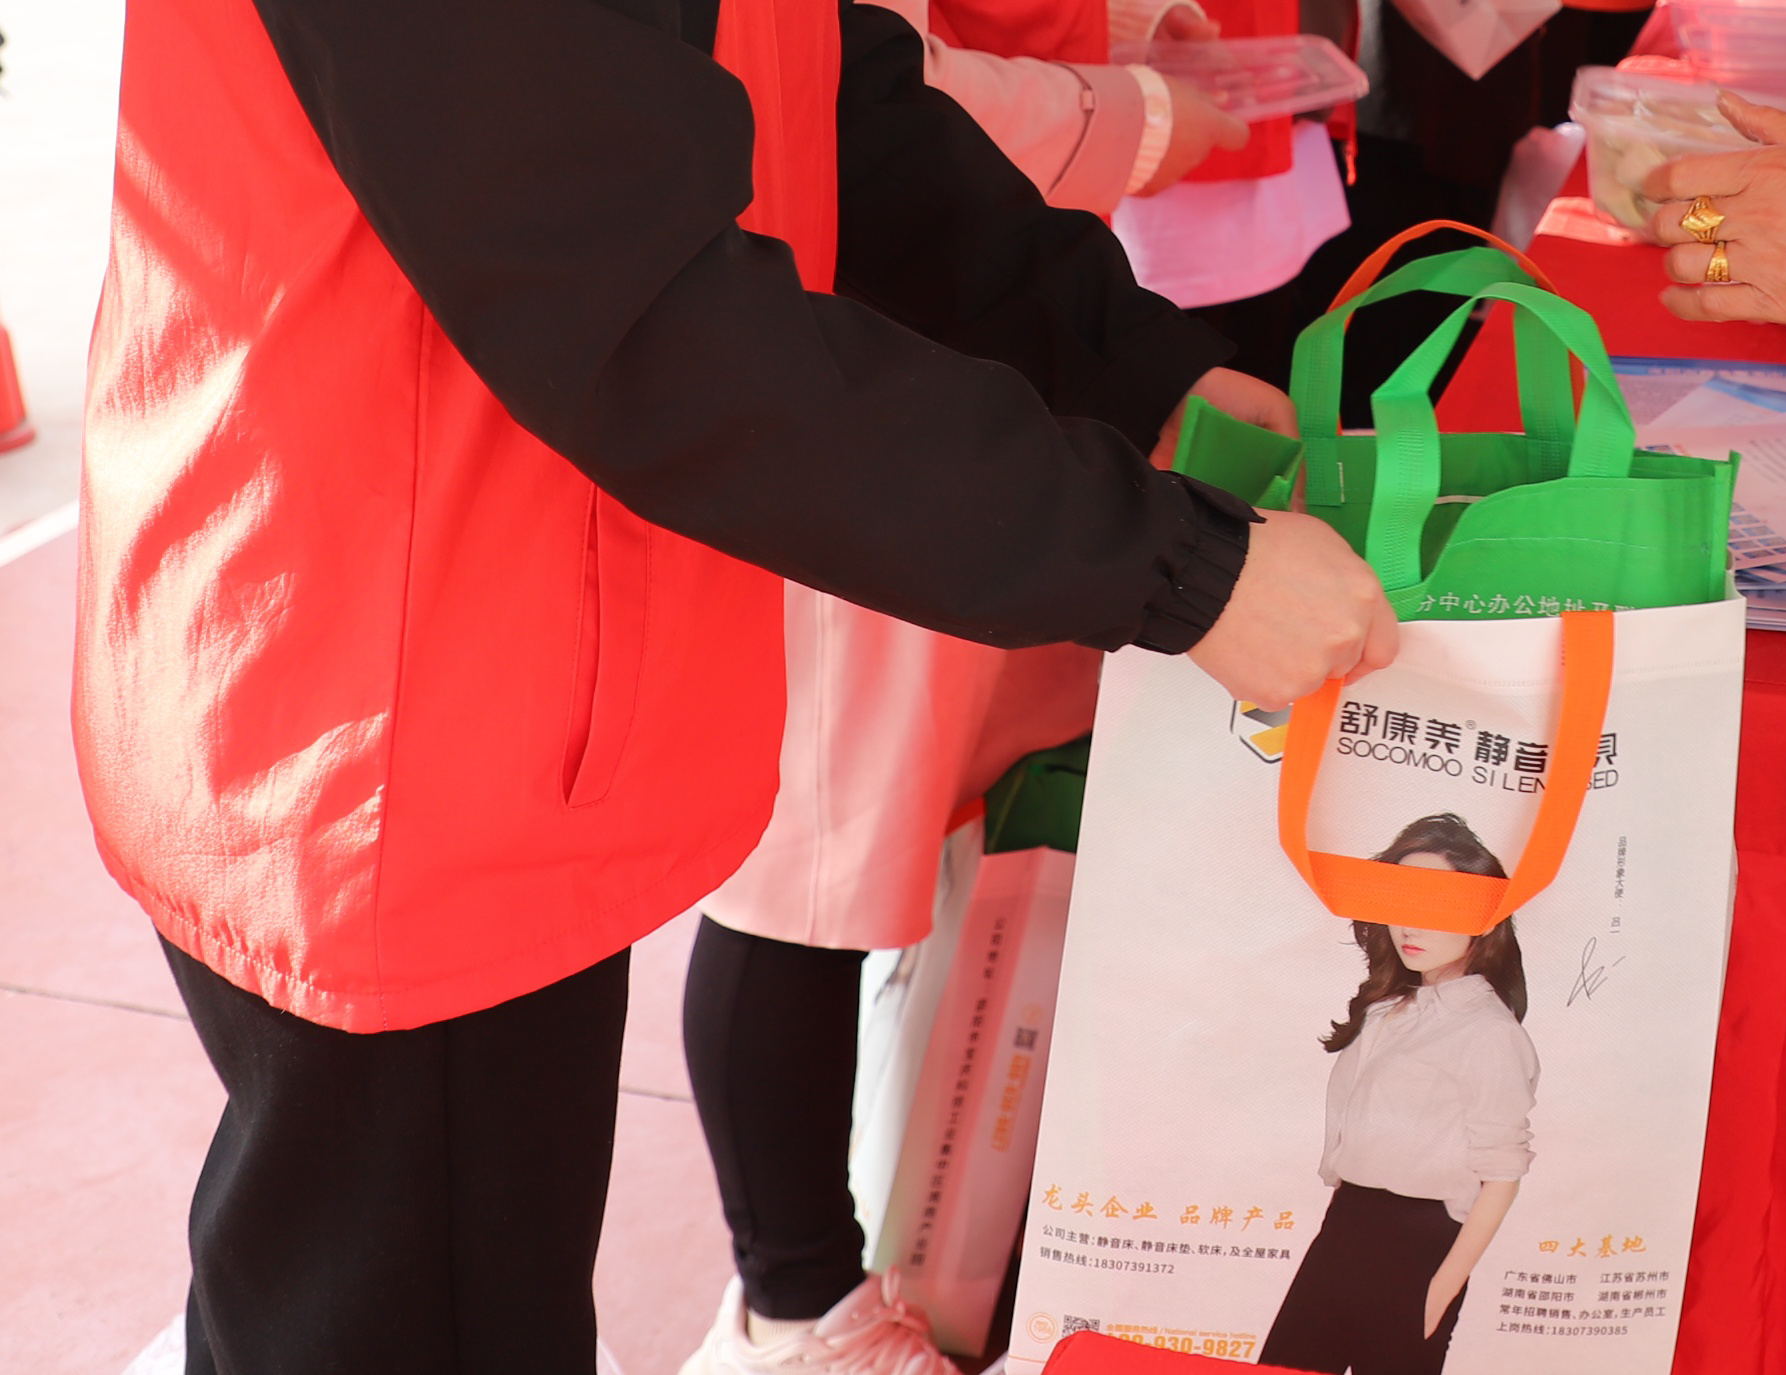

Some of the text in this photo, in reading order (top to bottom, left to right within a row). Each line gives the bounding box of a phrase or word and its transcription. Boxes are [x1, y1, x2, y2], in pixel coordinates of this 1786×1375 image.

[1336, 736, 1463, 777] SOCOMOO
[1041, 1183, 1296, 1232] 龙头企业 品牌产品
[1538, 1234, 1647, 1258] 四大基地
[1504, 1270, 1670, 1285] 广东省佛山市 江苏省苏州市
[1501, 1287, 1668, 1302] 湖南省邵阳市 湖南省郴州市
